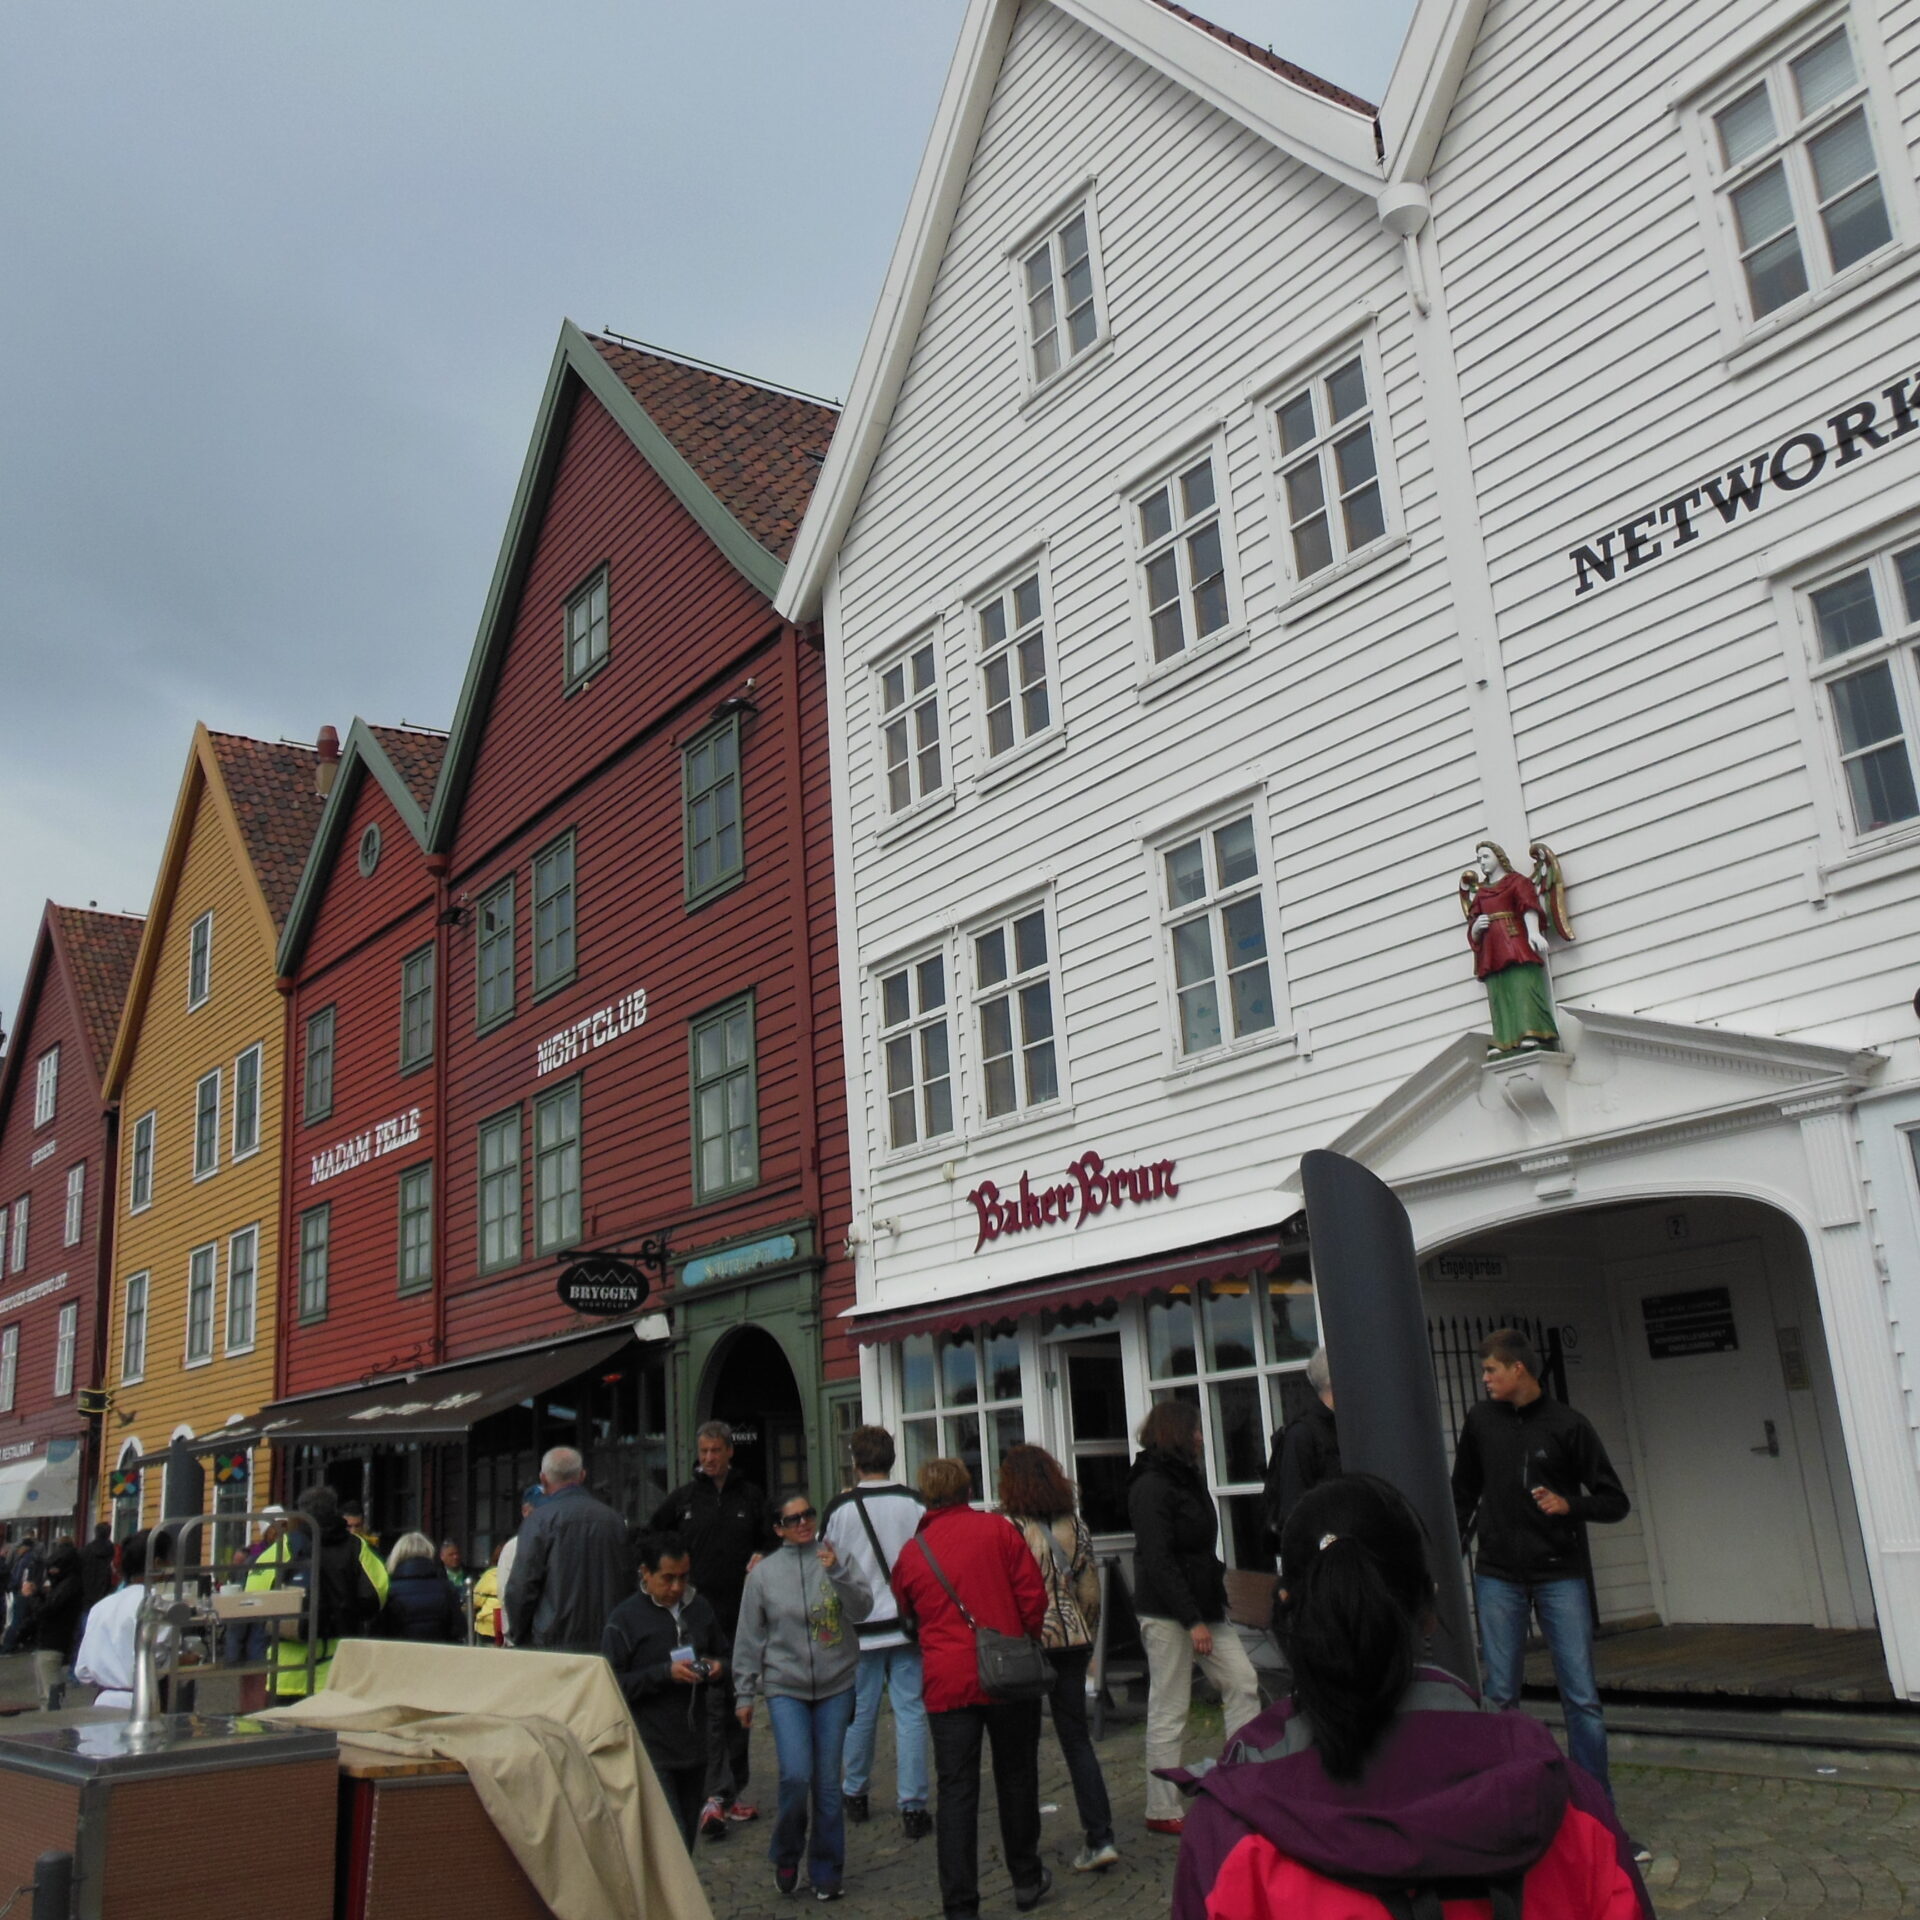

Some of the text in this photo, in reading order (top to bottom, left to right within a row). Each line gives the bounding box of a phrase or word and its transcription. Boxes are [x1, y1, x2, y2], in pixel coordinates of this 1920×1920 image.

[1569, 374, 1920, 596] NETWORK
[537, 988, 647, 1077] NIGHTCLUB
[310, 1108, 420, 1186] MADAM FELLE
[569, 1285, 638, 1301] BRYGGEN
